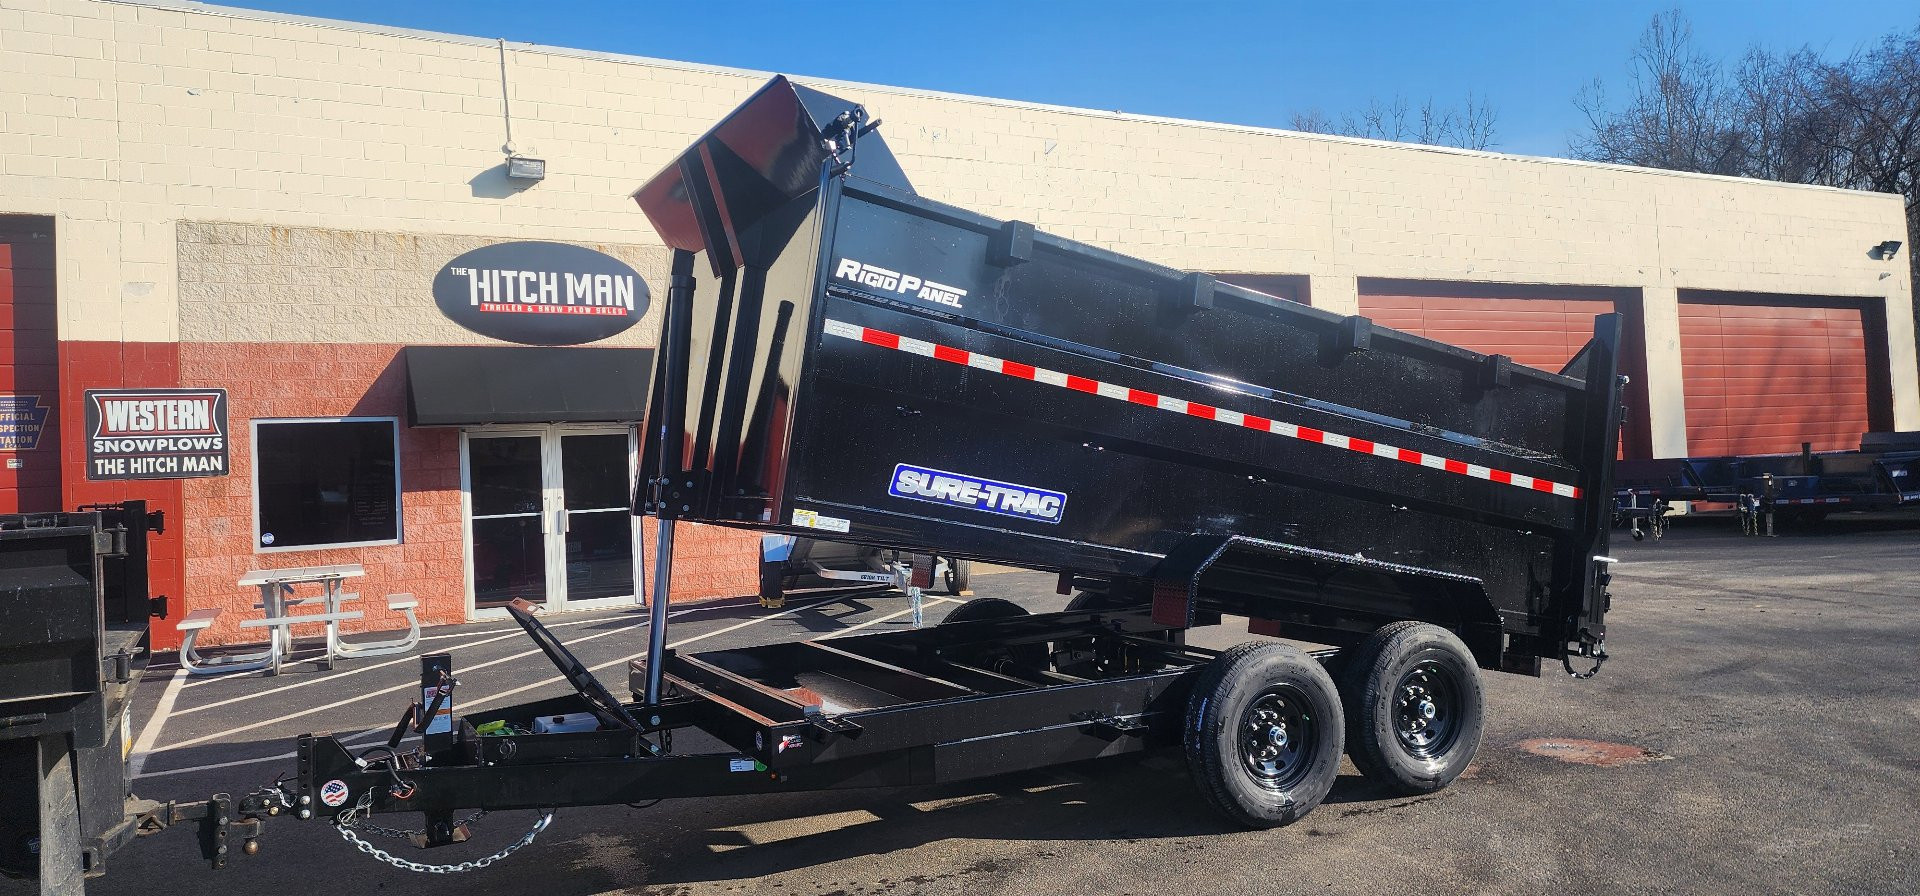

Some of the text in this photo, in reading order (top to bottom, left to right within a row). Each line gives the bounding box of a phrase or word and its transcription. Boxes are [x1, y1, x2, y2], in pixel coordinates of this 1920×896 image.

[450, 267, 468, 276] THE
[835, 257, 900, 291] RIGID
[897, 274, 967, 309] PANEL
[468, 268, 635, 311] HITCH MAN
[483, 303, 522, 312] TRAILER
[538, 305, 563, 313] SNOW
[595, 307, 623, 315] SALES
[104, 399, 210, 432] WESTERN
[93, 437, 223, 453] SNOWPLOWS
[95, 455, 223, 475] THE HITCH MAN
[895, 469, 1060, 518] SURE-TRAC
